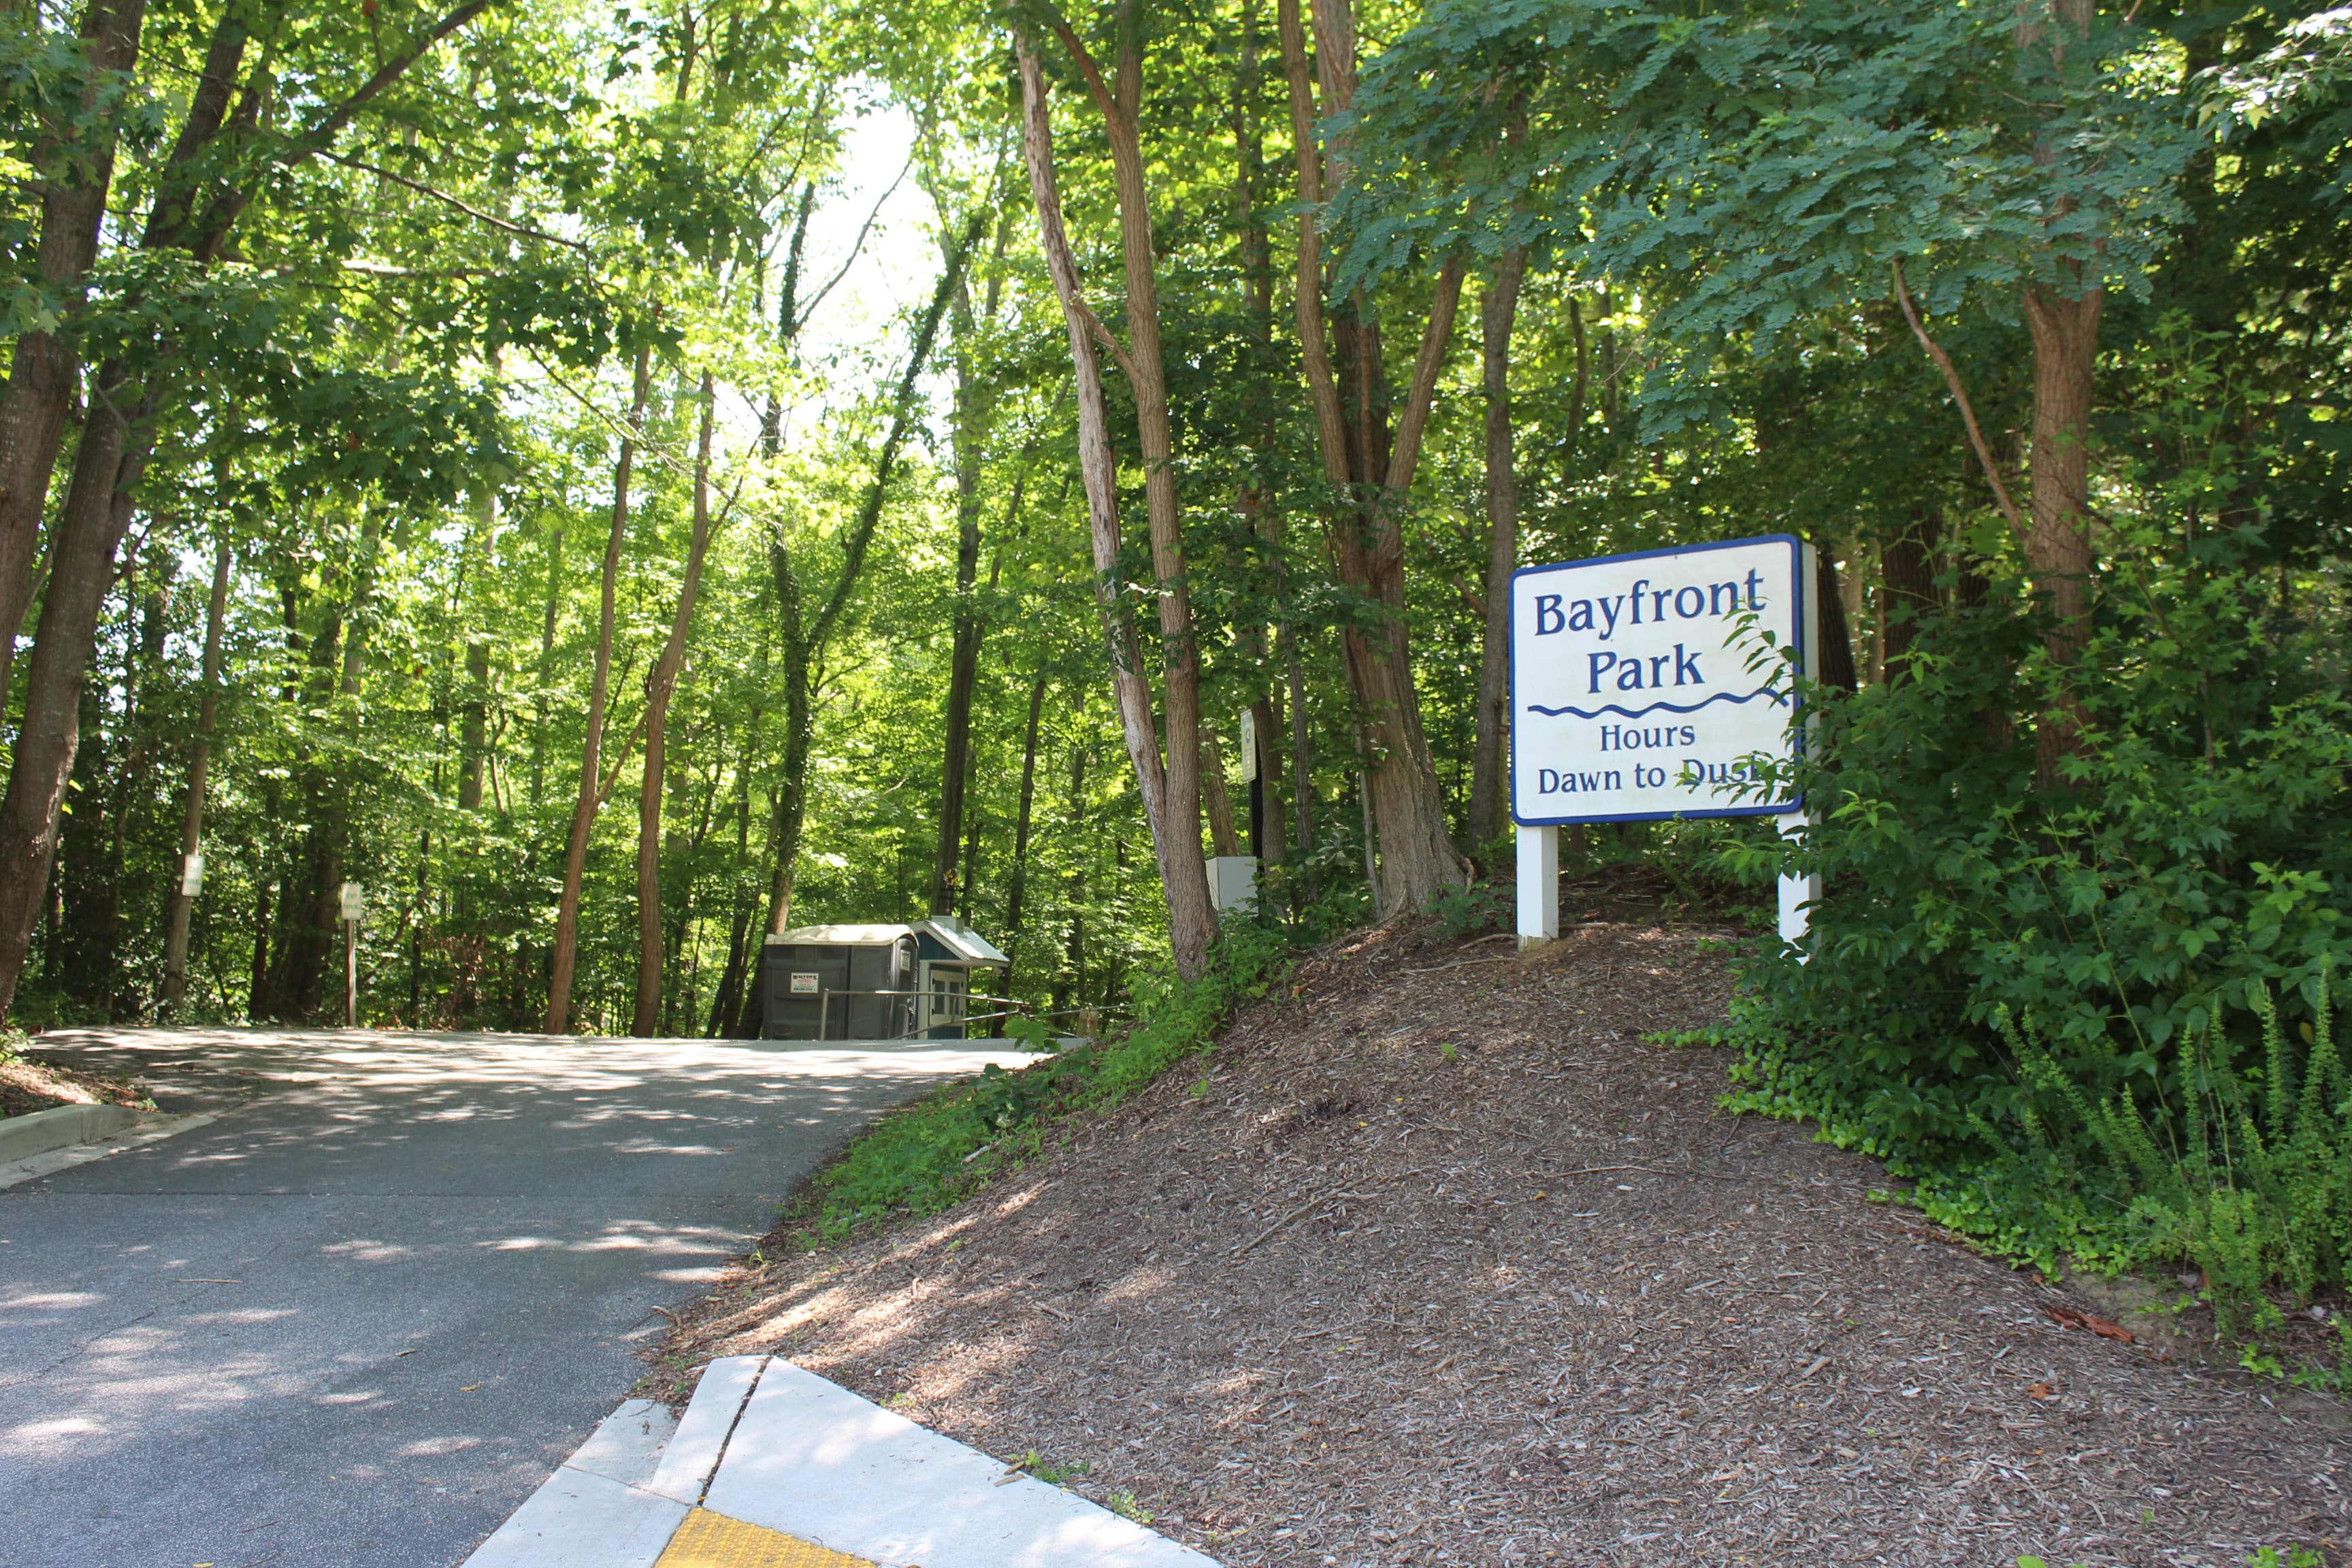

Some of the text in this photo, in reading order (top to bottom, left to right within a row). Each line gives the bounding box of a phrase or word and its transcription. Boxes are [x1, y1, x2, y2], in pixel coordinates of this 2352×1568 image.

[1535, 568, 1765, 640] Bayfront
[1588, 643, 1705, 693] Park
[1601, 725, 1695, 751] Hours
[1539, 768, 1622, 794] Dawn
[1635, 763, 1666, 789] to
